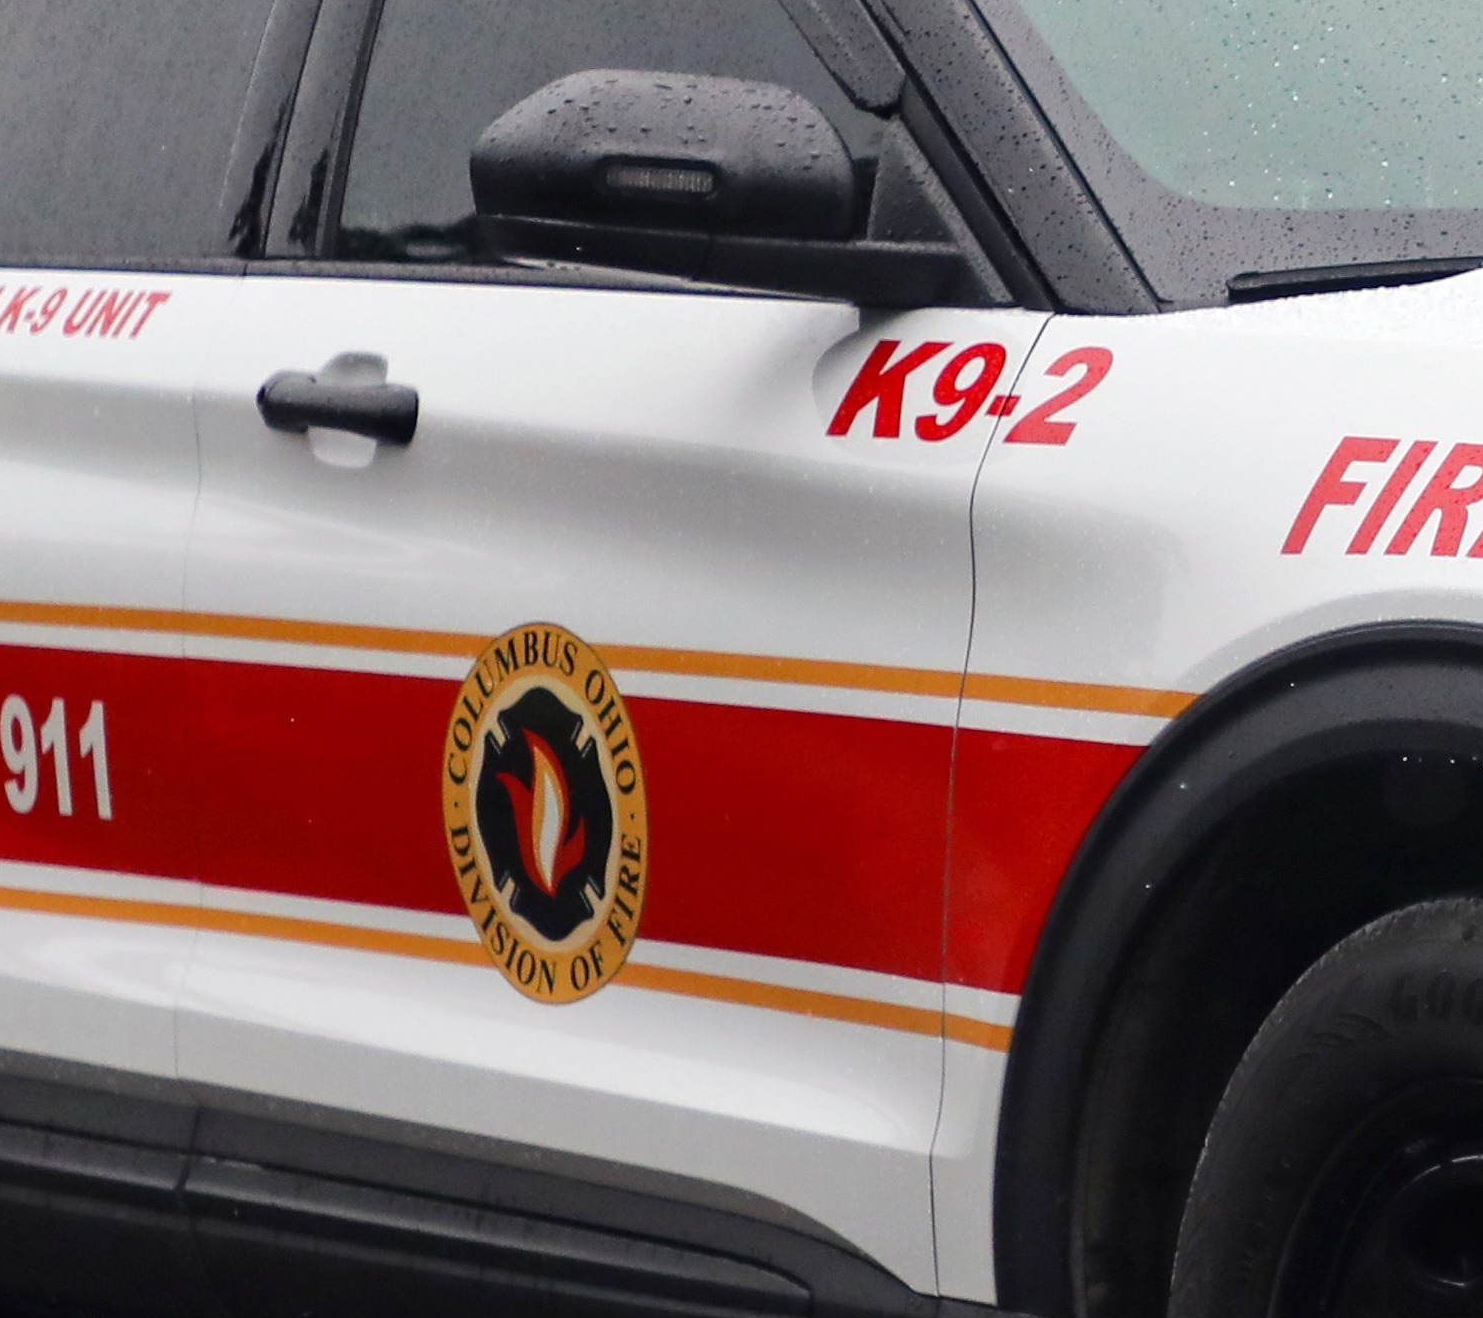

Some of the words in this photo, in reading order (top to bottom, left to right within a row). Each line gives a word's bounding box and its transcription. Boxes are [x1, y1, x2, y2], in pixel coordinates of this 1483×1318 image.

[62, 289, 171, 340] UNIT
[826, 339, 1113, 445] K9-2
[0, 694, 113, 821] 911
[447, 630, 578, 787] COLUMBUS
[584, 668, 637, 795] OHIO
[450, 825, 557, 996] DIVISION
[570, 940, 605, 992] OF
[607, 833, 642, 948] FIRE
